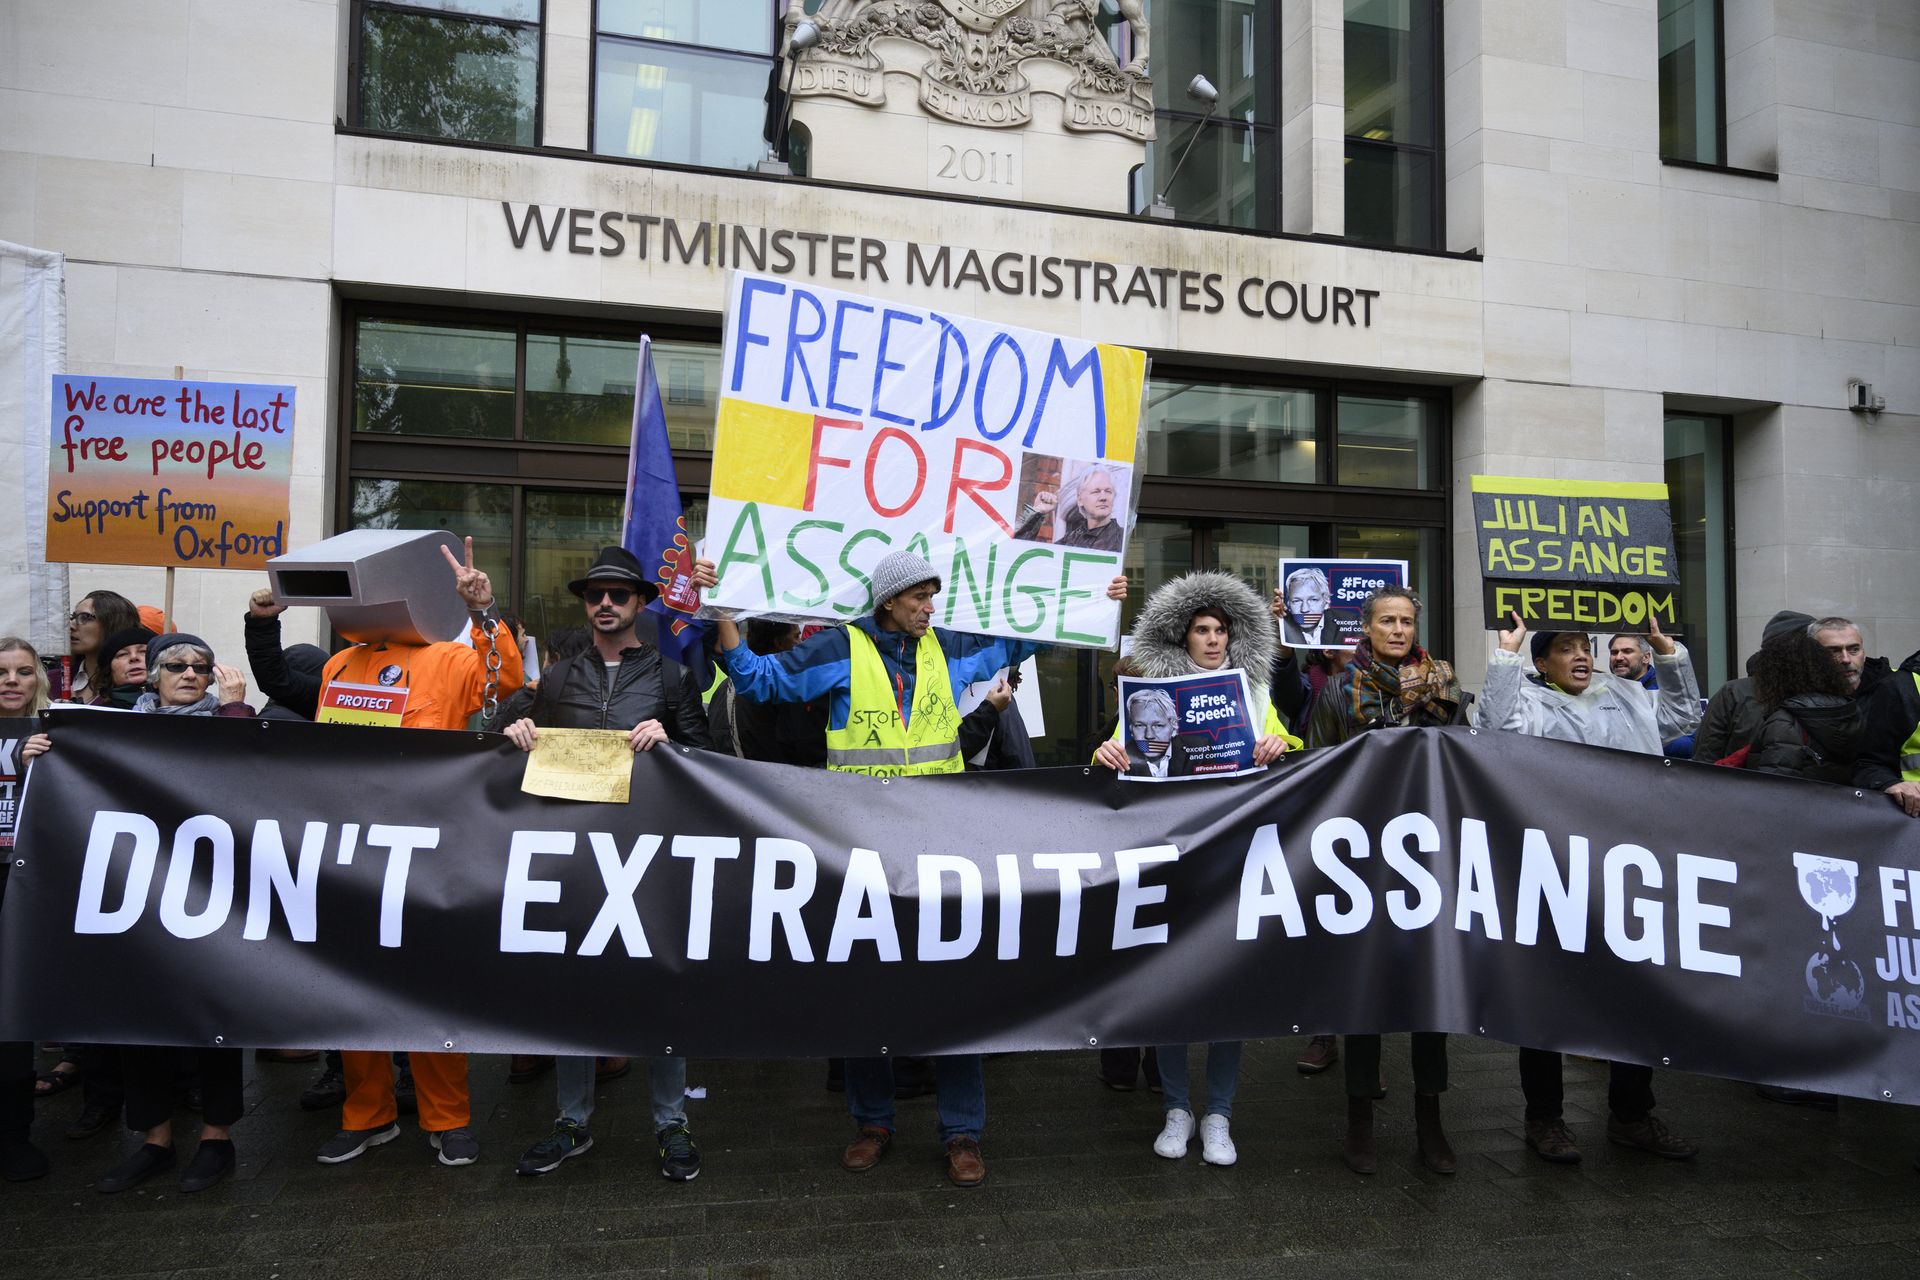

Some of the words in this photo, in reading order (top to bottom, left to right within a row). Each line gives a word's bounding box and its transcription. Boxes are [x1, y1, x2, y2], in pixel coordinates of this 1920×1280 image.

[800, 66, 871, 97] DIEU
[962, 95, 1028, 124] MON
[1072, 103, 1150, 136] DROIT
[937, 144, 1014, 185] 2011
[502, 202, 888, 282] WESTMINSTER
[906, 242, 1224, 312] MAGISTRATES
[1237, 277, 1381, 327] COURT
[731, 278, 1105, 459] FREEDOM
[65, 381, 108, 412] We
[113, 394, 166, 417] are
[175, 387, 225, 425] the
[232, 389, 289, 434] last
[61, 414, 128, 473] free
[151, 430, 265, 480] people
[803, 415, 1015, 539] FOR
[53, 490, 150, 534] Support
[154, 488, 216, 535] from
[1483, 498, 1630, 538] JULIAN
[174, 520, 283, 566] Oxford
[1488, 537, 1668, 577] ASSANGE
[707, 502, 1118, 645] ASSNGE
[1342, 577, 1385, 588] #Free
[1495, 587, 1676, 625] FREEDOM
[336, 694, 393, 710] PROTECT
[853, 710, 900, 728] STOP
[1189, 694, 1227, 709] #Free
[1205, 750, 1241, 759] corruption
[1224, 740, 1246, 748] crimes
[73, 809, 440, 949] DON'T
[499, 829, 1181, 963] EXTRADITE
[1236, 812, 1741, 978] ASSANGE
